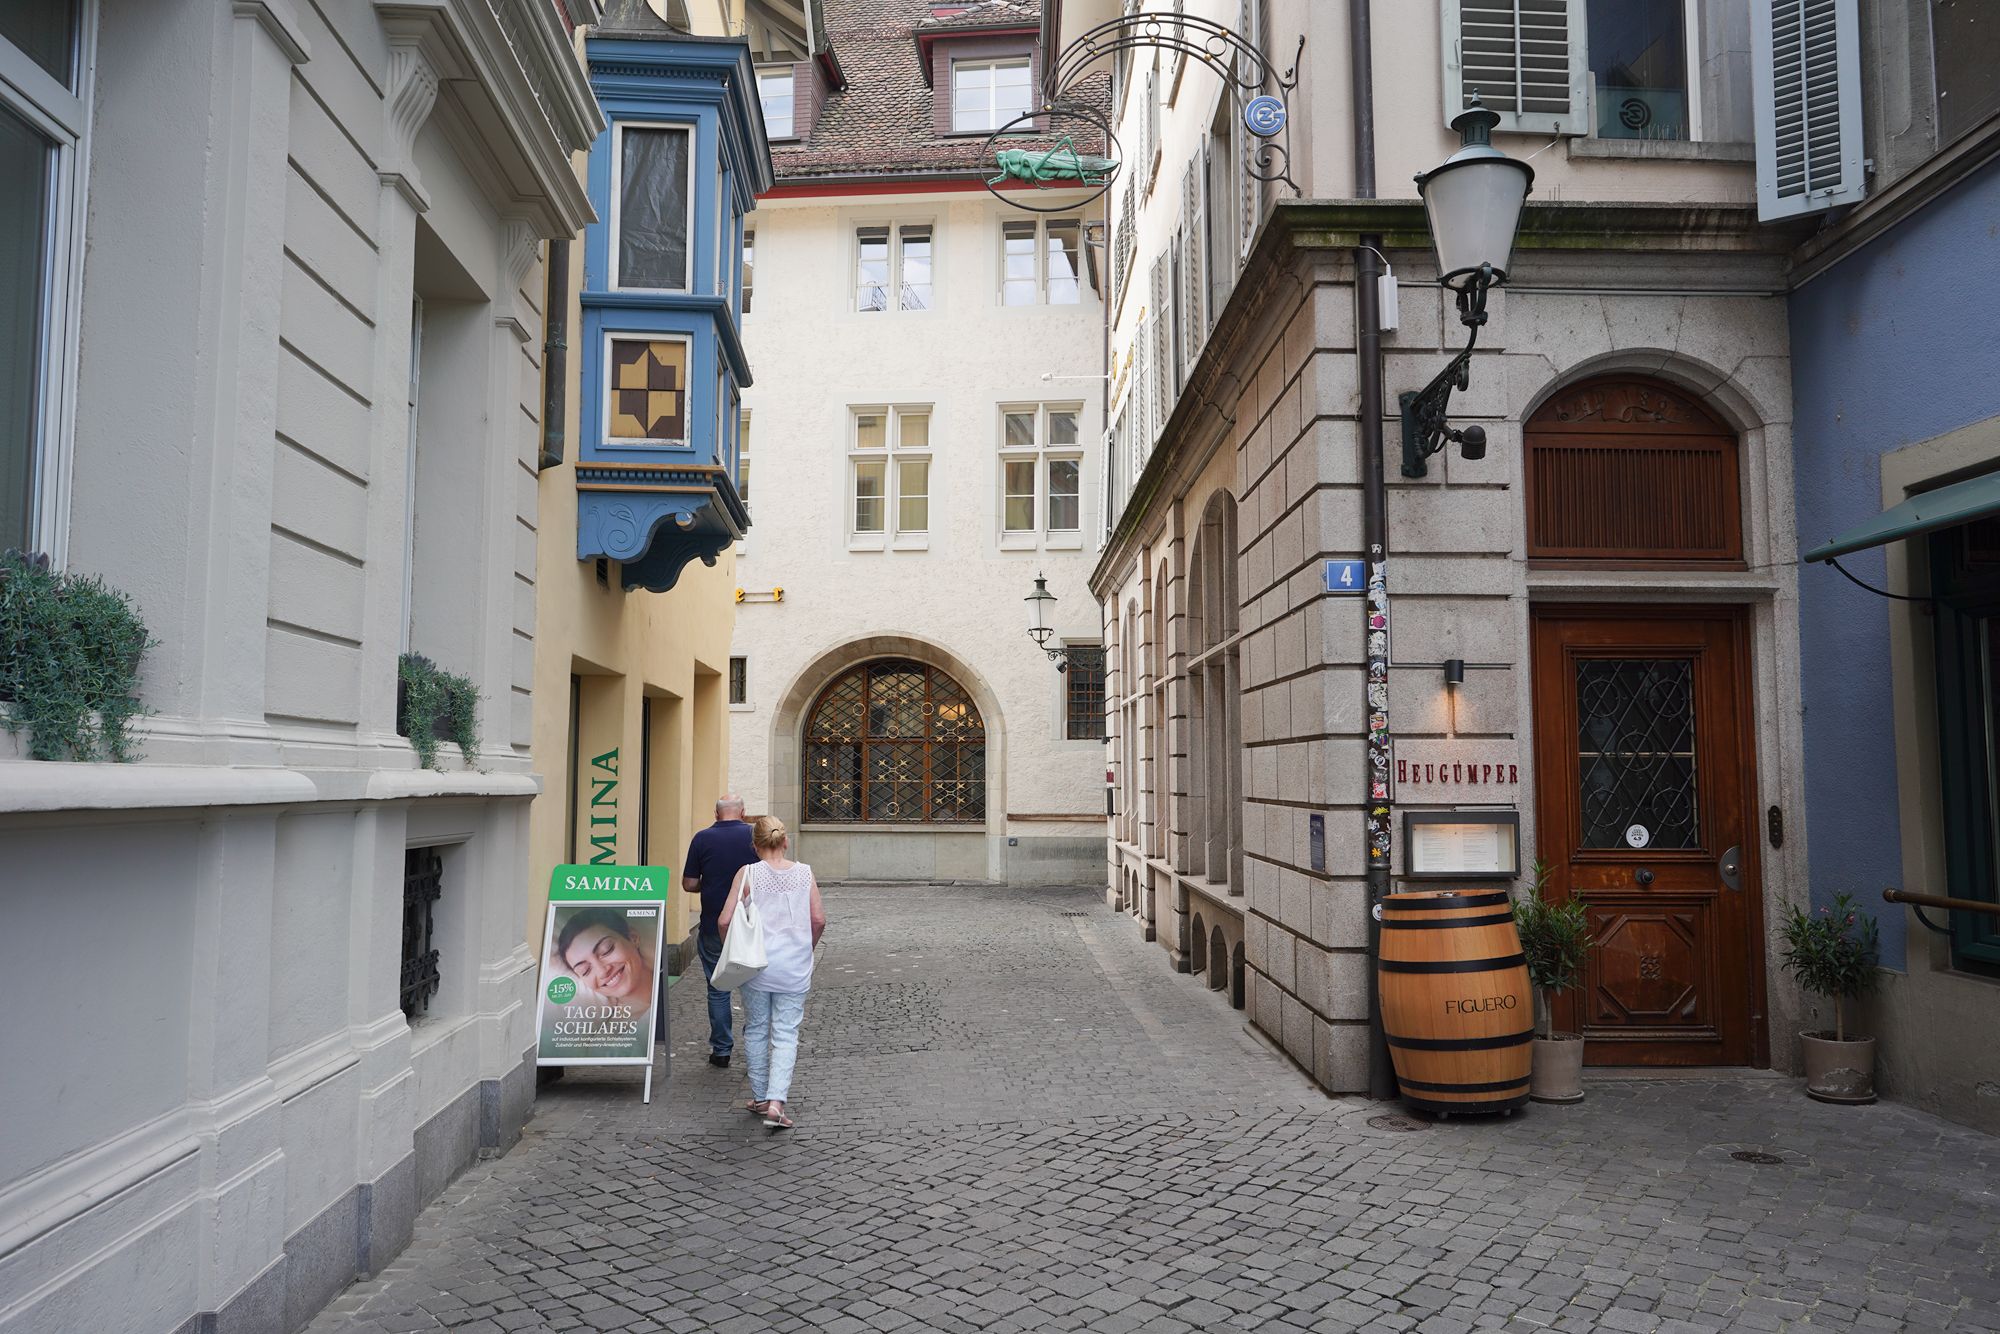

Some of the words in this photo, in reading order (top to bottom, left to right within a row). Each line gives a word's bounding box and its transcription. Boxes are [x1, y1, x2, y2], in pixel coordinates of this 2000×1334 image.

[1340, 565, 1353, 587] 4
[565, 875, 653, 891] SAMINA
[549, 982, 574, 994] -15%
[1445, 994, 1517, 1014] FIGUERO
[563, 1005, 596, 1019] TAG
[600, 1005, 632, 1019] DES
[554, 1021, 638, 1035] SCHLAFES
